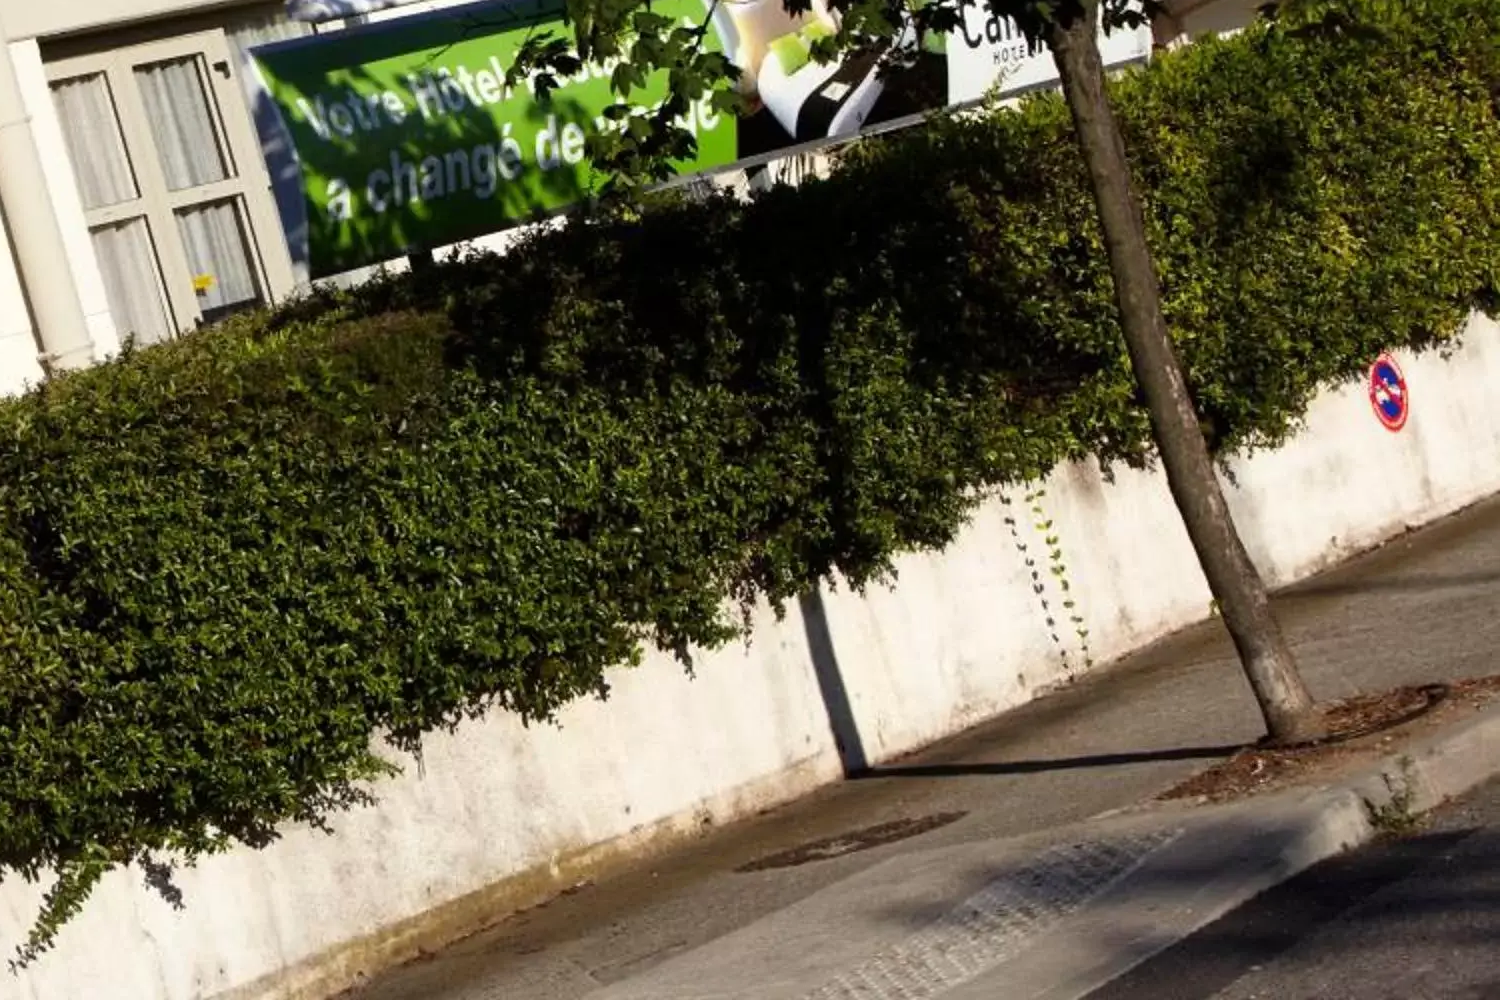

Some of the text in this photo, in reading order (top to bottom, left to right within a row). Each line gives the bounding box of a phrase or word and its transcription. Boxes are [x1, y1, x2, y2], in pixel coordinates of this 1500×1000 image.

[295, 89, 407, 141] Votre
[406, 55, 513, 124] Hôtel
[366, 121, 523, 213] changé
[535, 113, 585, 171] de
